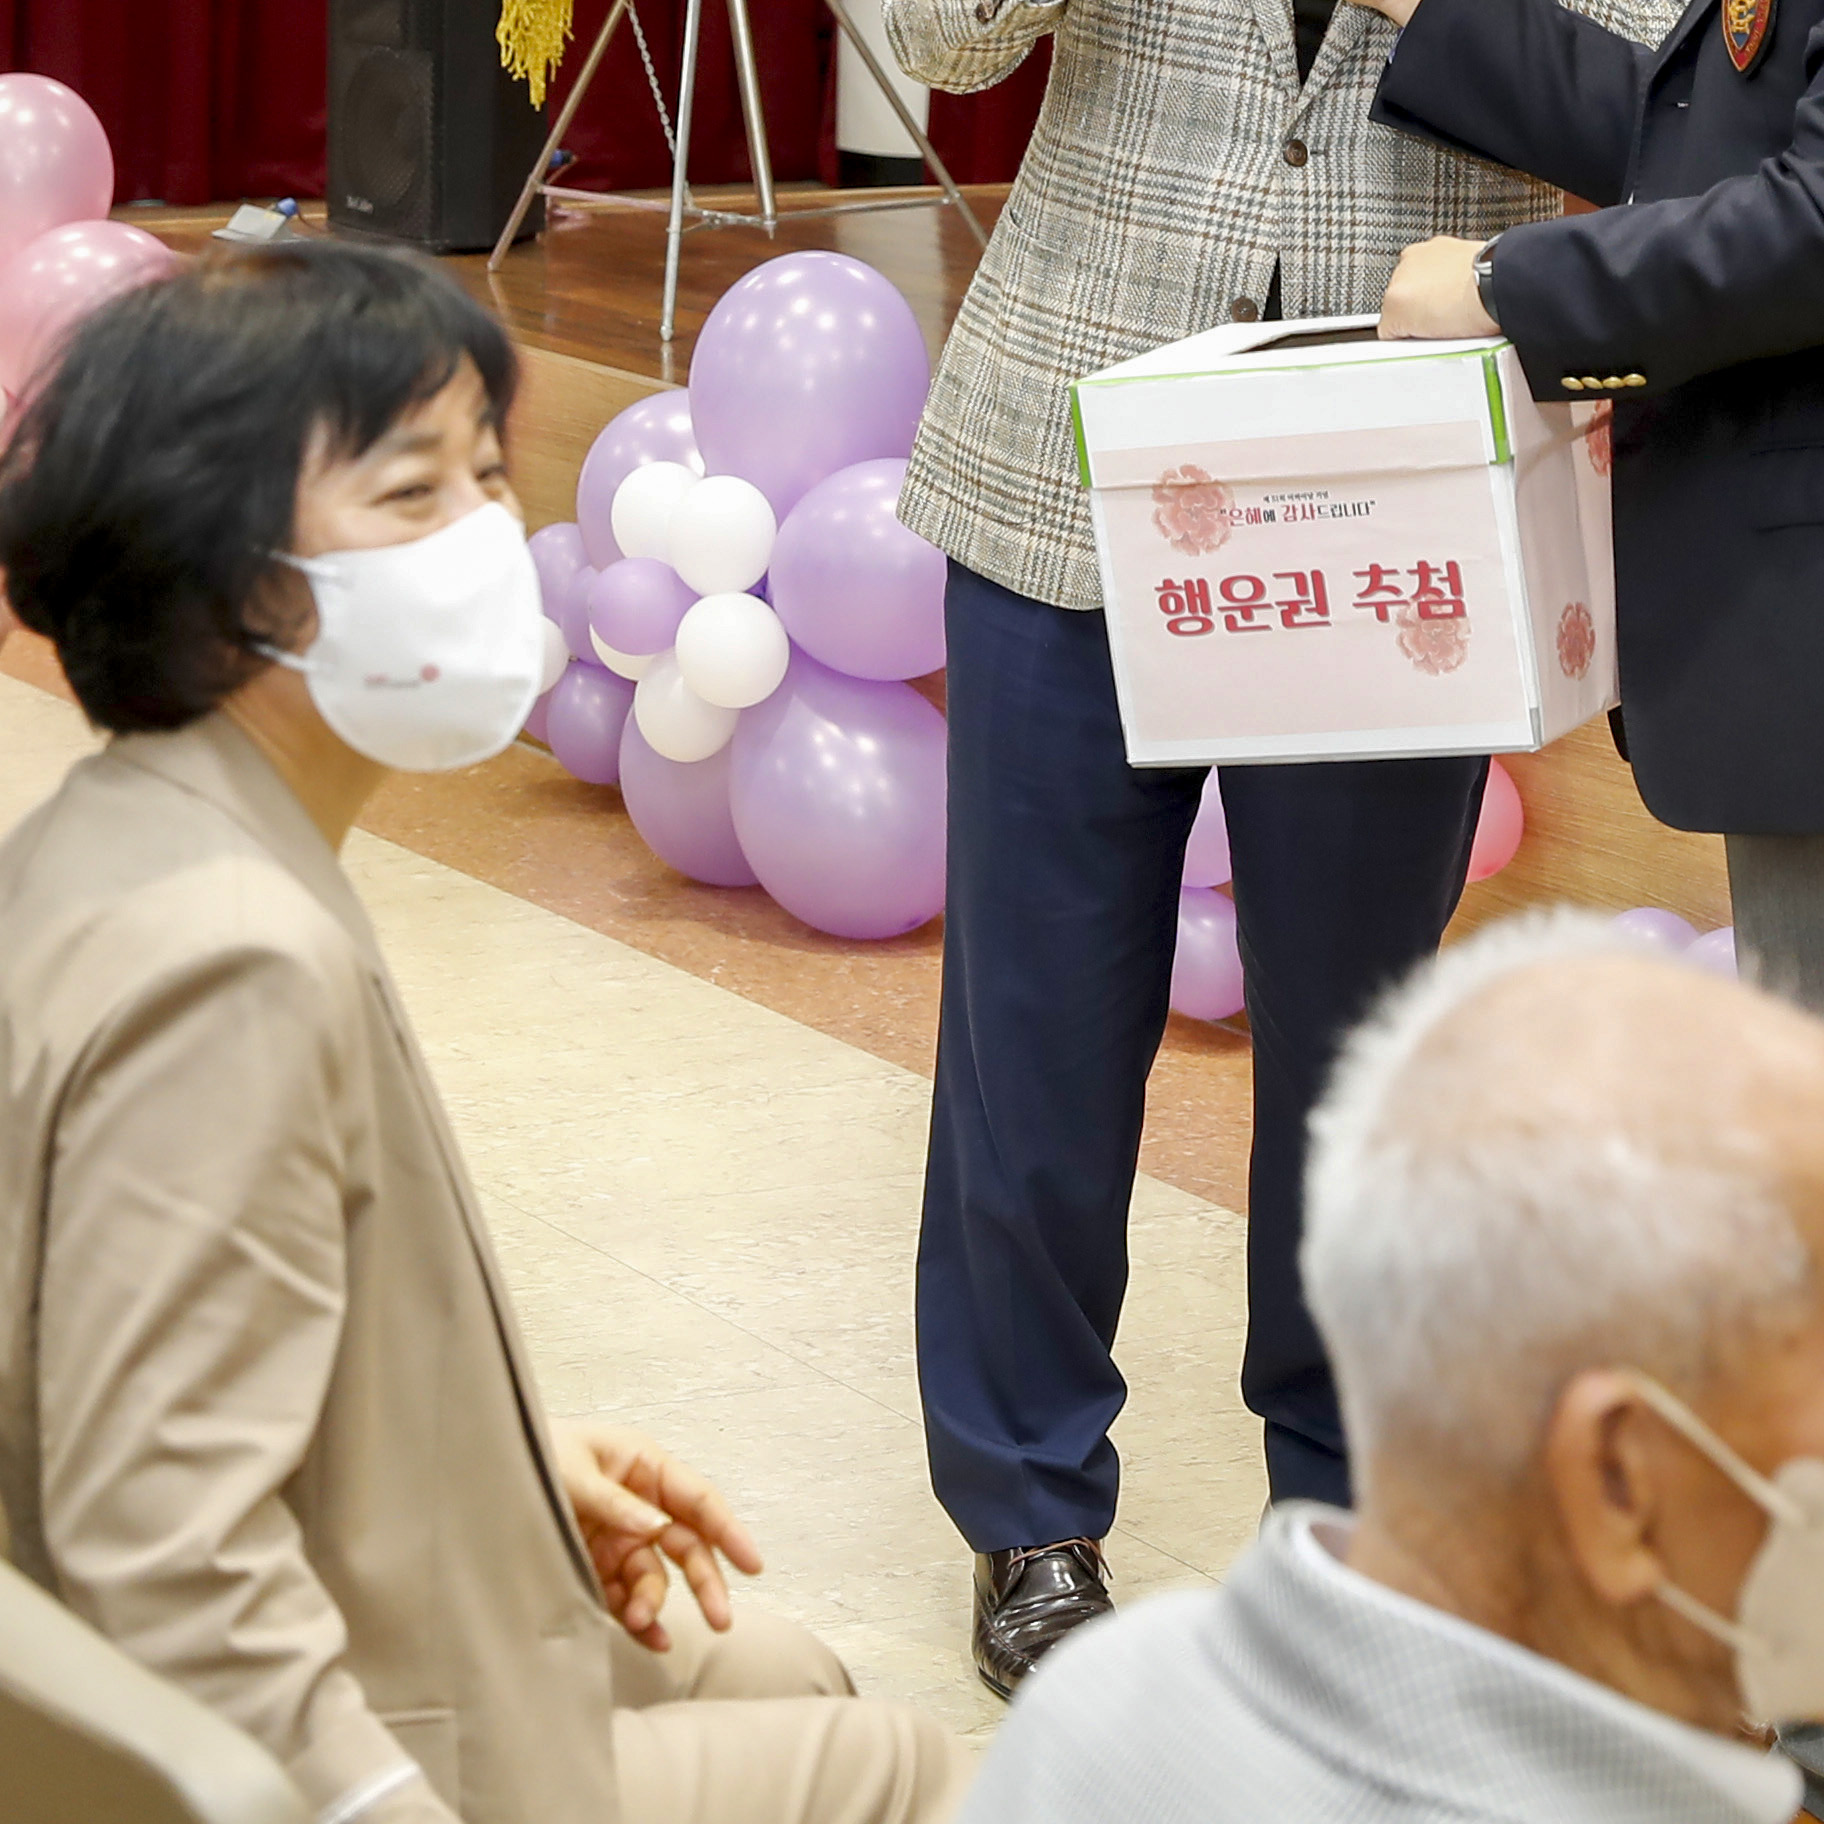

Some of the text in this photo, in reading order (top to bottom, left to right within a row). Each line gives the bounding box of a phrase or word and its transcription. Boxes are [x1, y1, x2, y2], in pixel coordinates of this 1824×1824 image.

[1220, 499, 1376, 526] "은혜에 감사드립니다"
[1155, 560, 1467, 637] 행운권 추첨
